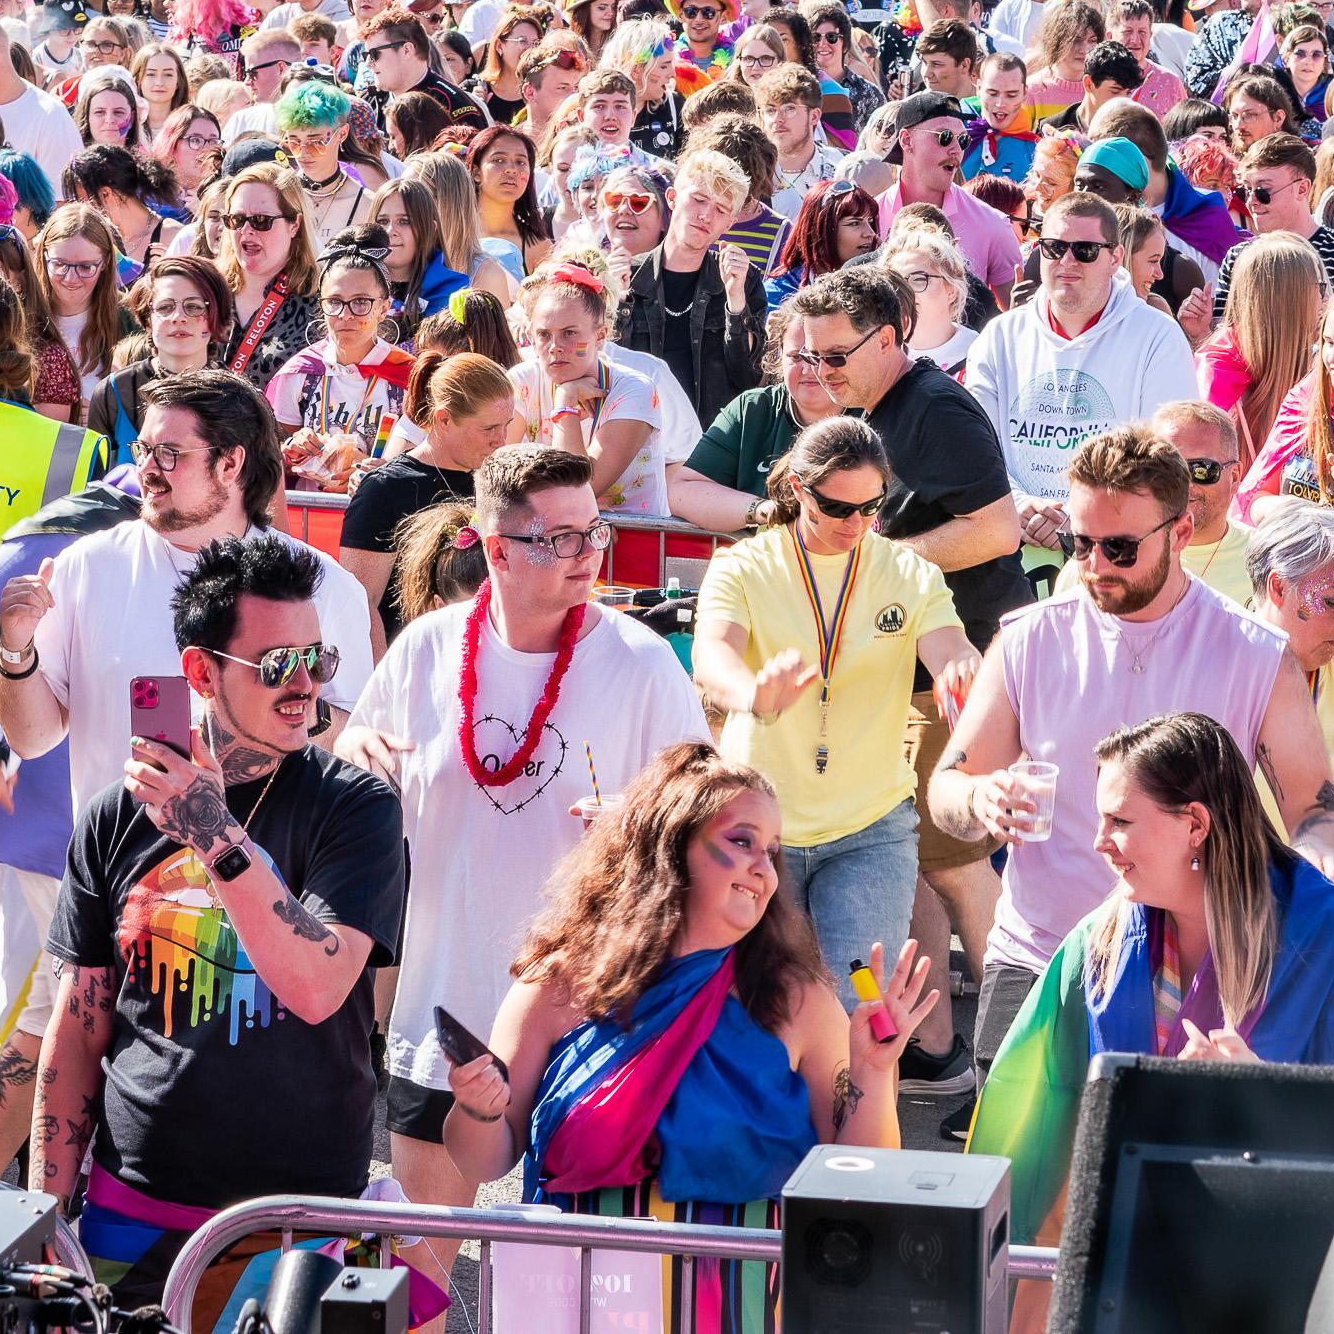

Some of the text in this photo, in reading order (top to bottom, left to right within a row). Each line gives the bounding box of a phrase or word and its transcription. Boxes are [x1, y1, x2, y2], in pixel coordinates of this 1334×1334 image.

[246, 299, 277, 346] PELOTON
[1039, 404, 1087, 416] DOWN TOWN
[481, 753, 545, 778] Qer
